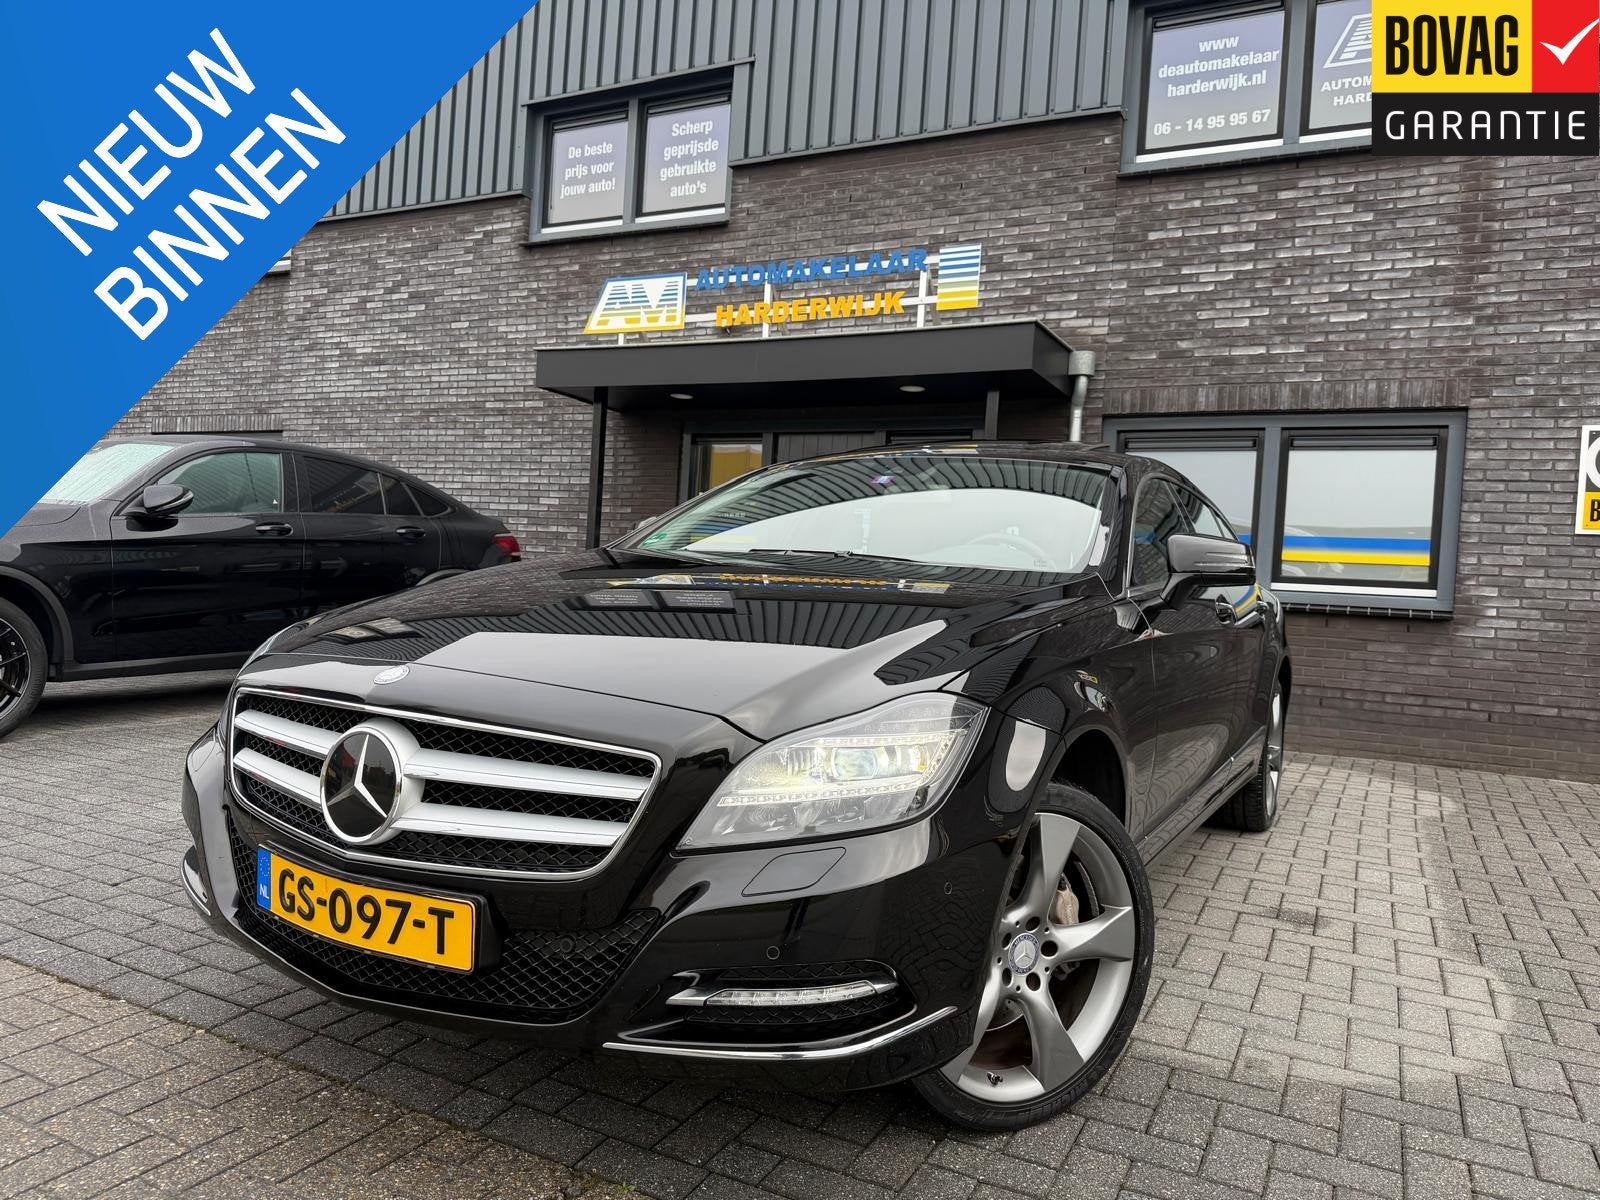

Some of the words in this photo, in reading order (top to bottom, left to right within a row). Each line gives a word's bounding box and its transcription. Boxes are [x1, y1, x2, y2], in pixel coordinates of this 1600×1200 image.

[1199, 35, 1239, 53] www
[1158, 50, 1280, 79] deautomakelaar
[1167, 69, 1267, 98] harderwijk.nl
[671, 120, 713, 137] Scherp
[1153, 122, 1171, 136] 06
[1186, 117, 1203, 132] 14
[1207, 114, 1226, 129] 95
[1230, 111, 1248, 126] 95
[1252, 108, 1272, 123] 67
[568, 147, 582, 159] De
[584, 142, 613, 157] beste
[663, 139, 719, 161] geprijsde
[565, 165, 588, 181] prijs
[591, 161, 614, 175] voor
[660, 160, 717, 181] gebruikte
[560, 183, 586, 199] jouw
[588, 178, 616, 194] auto!
[670, 180, 707, 197] auto's
[694, 248, 927, 291] AUTOMAKELAAR
[715, 291, 904, 327] HARDERWIJK
[259, 885, 270, 900] NL
[278, 868, 454, 955] GS-097-T
